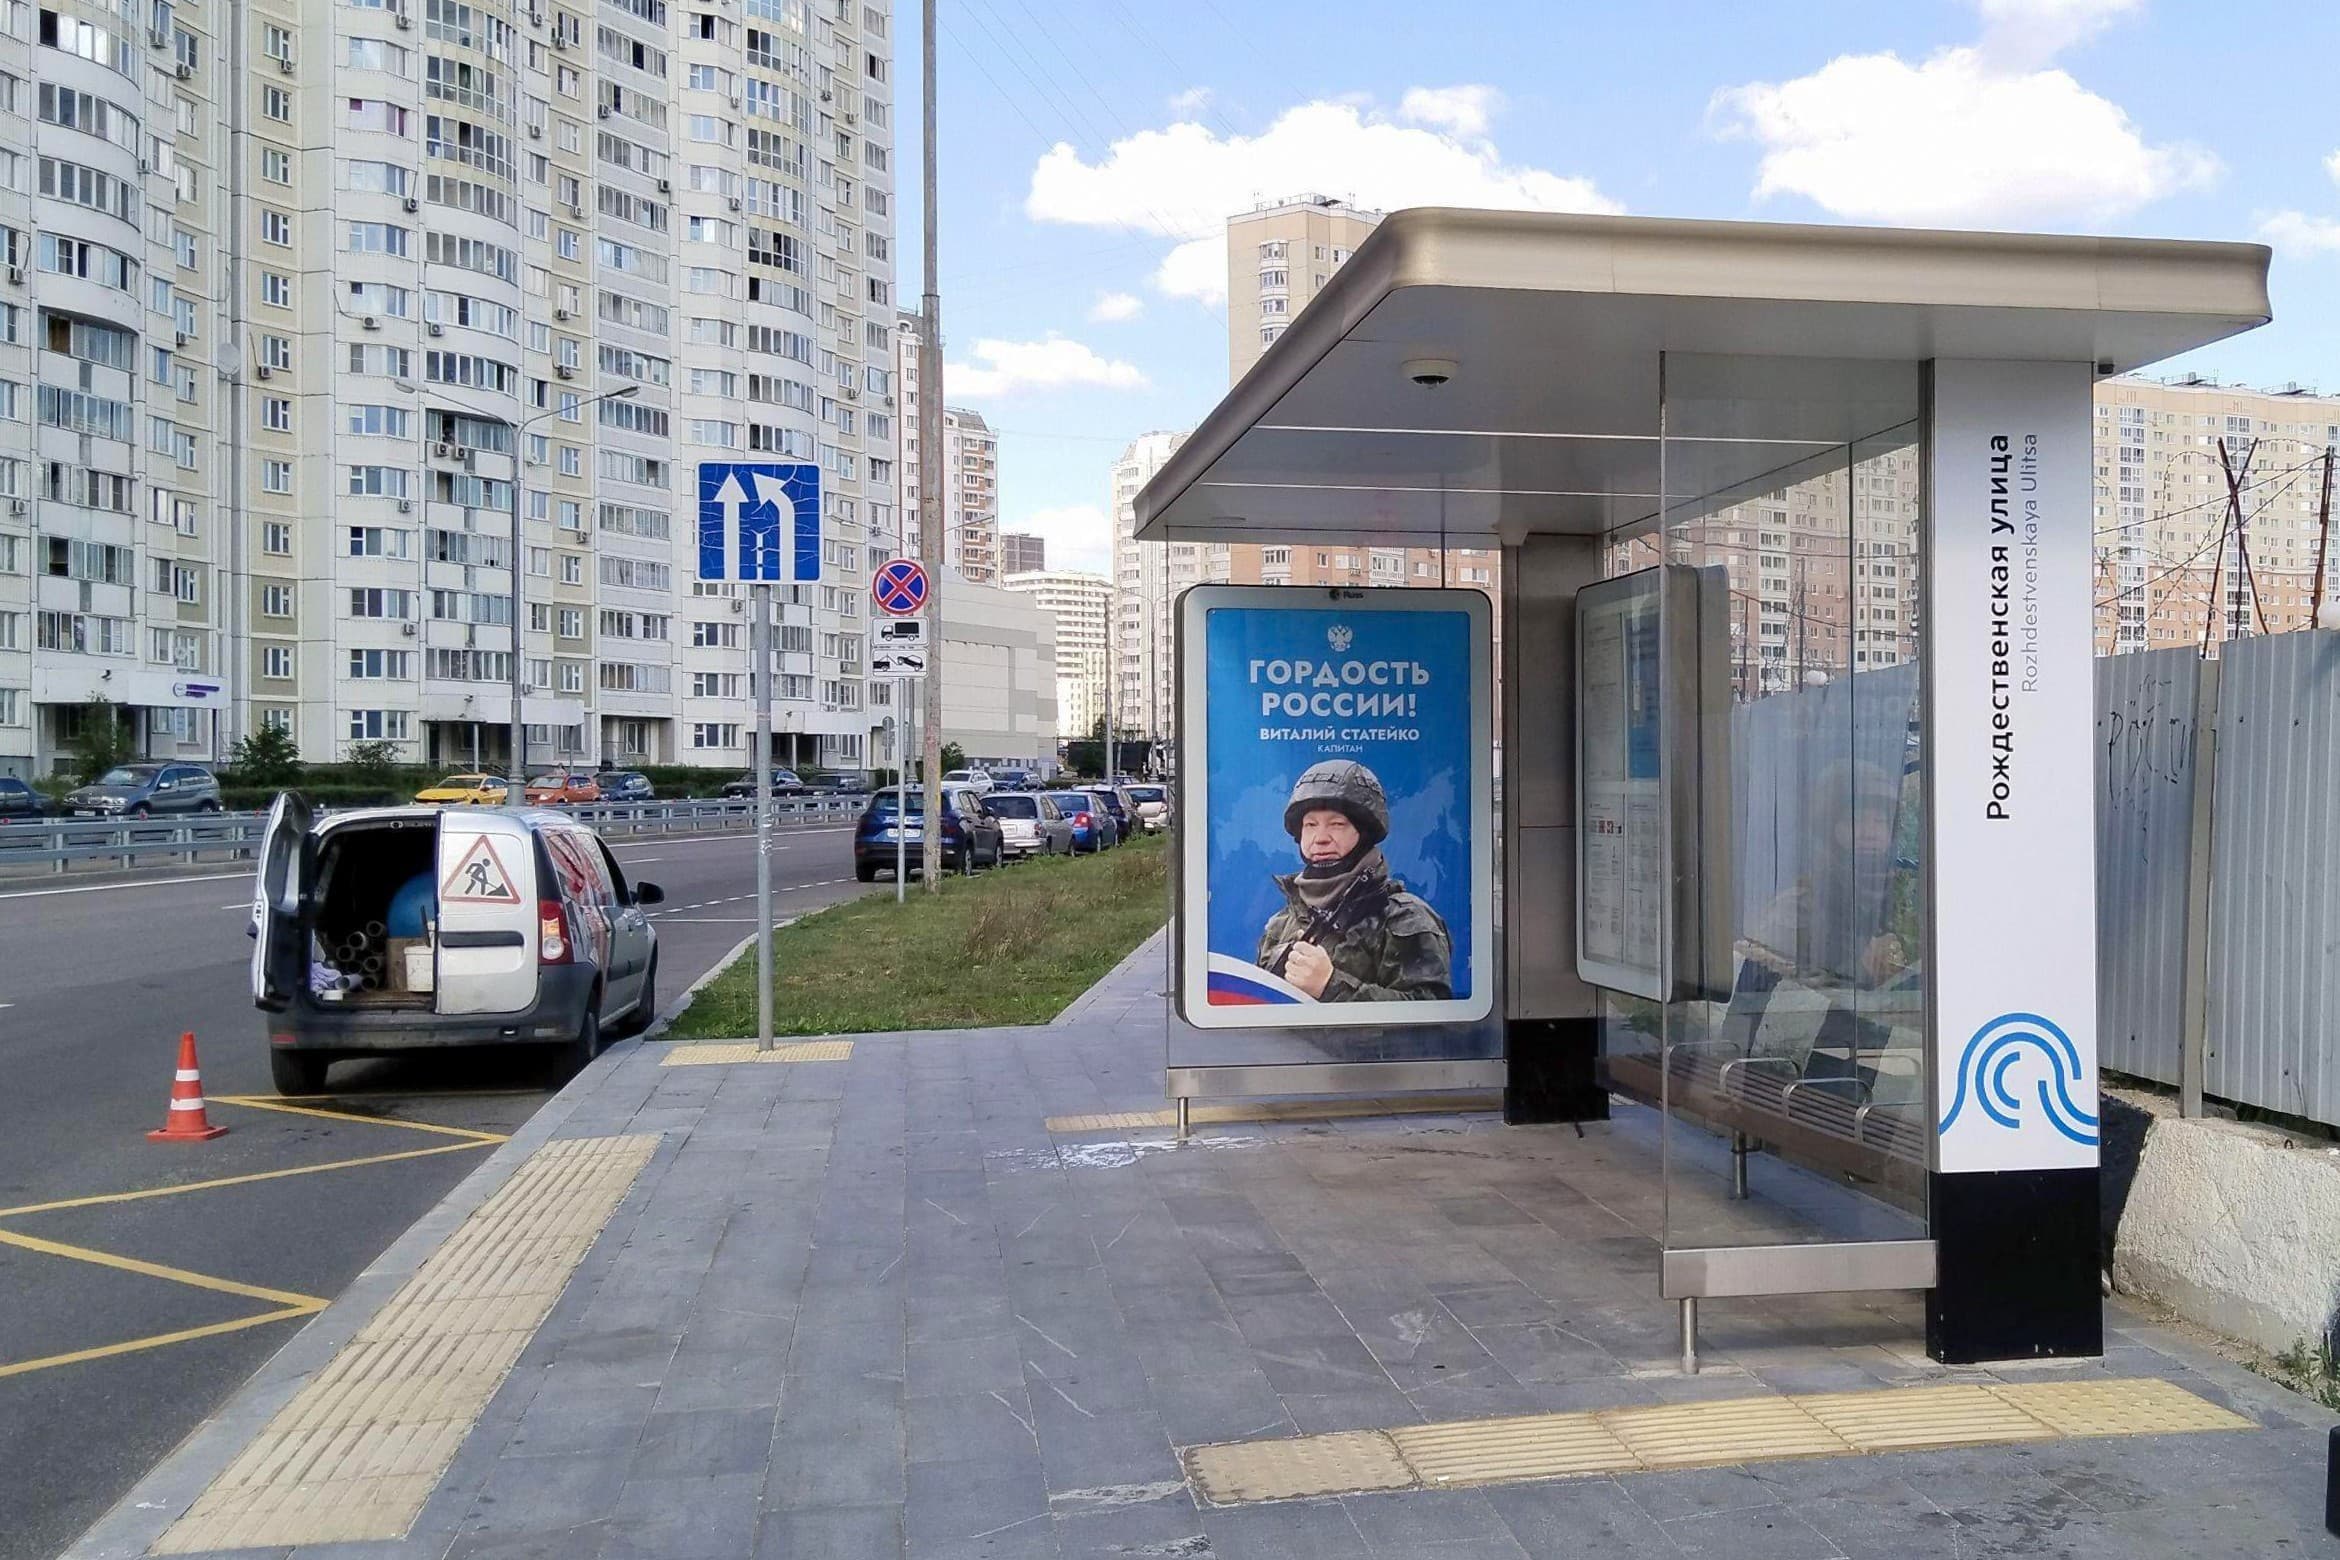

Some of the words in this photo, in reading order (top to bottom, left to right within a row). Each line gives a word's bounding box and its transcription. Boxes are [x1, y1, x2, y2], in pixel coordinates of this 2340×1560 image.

[2020, 433, 2037, 491] Ulitsa
[1990, 435, 2015, 534] улица
[2021, 499, 2039, 692] Rozhdestvenskaya
[1250, 660, 1430, 688] ГОРДОСТЬ
[1987, 545, 2013, 820] Рождественская
[1262, 692, 1417, 718] РОССИИ!
[1260, 726, 1336, 741] ВИТАЛИЙ
[1341, 725, 1420, 741] СТАТЕЙКО
[1317, 744, 1363, 753] КАПИТАН
